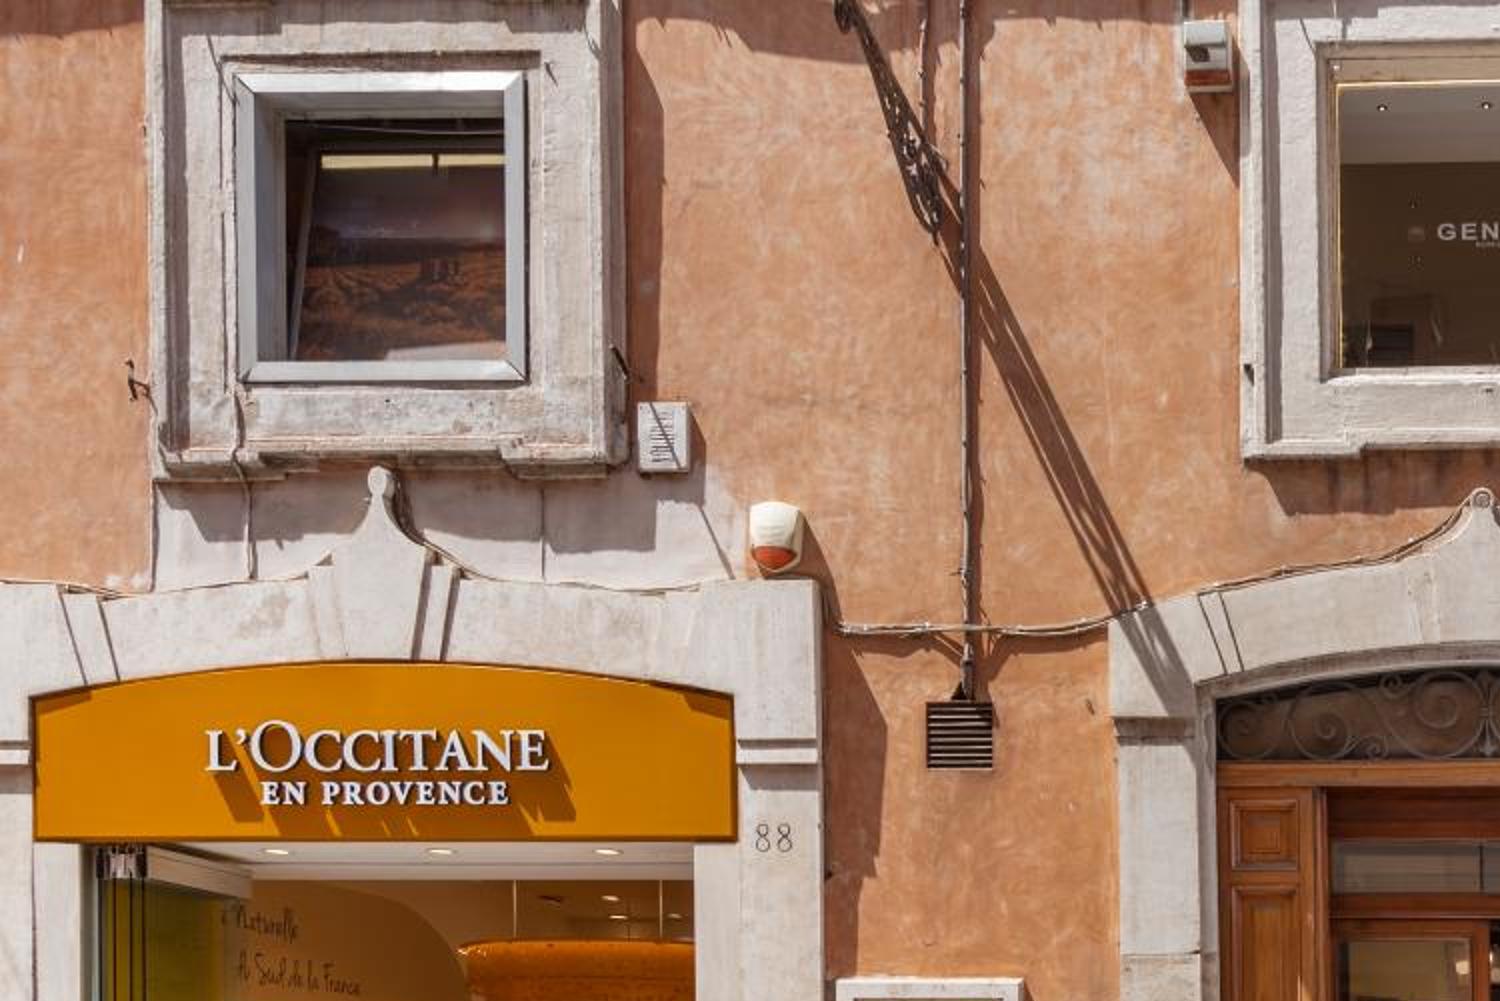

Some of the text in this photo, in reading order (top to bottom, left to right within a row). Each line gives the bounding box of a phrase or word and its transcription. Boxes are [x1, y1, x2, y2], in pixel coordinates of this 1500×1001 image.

[204, 720, 549, 772] L'OCCITANE
[260, 781, 509, 805] EN PROVENCE
[756, 823, 792, 853] 88
